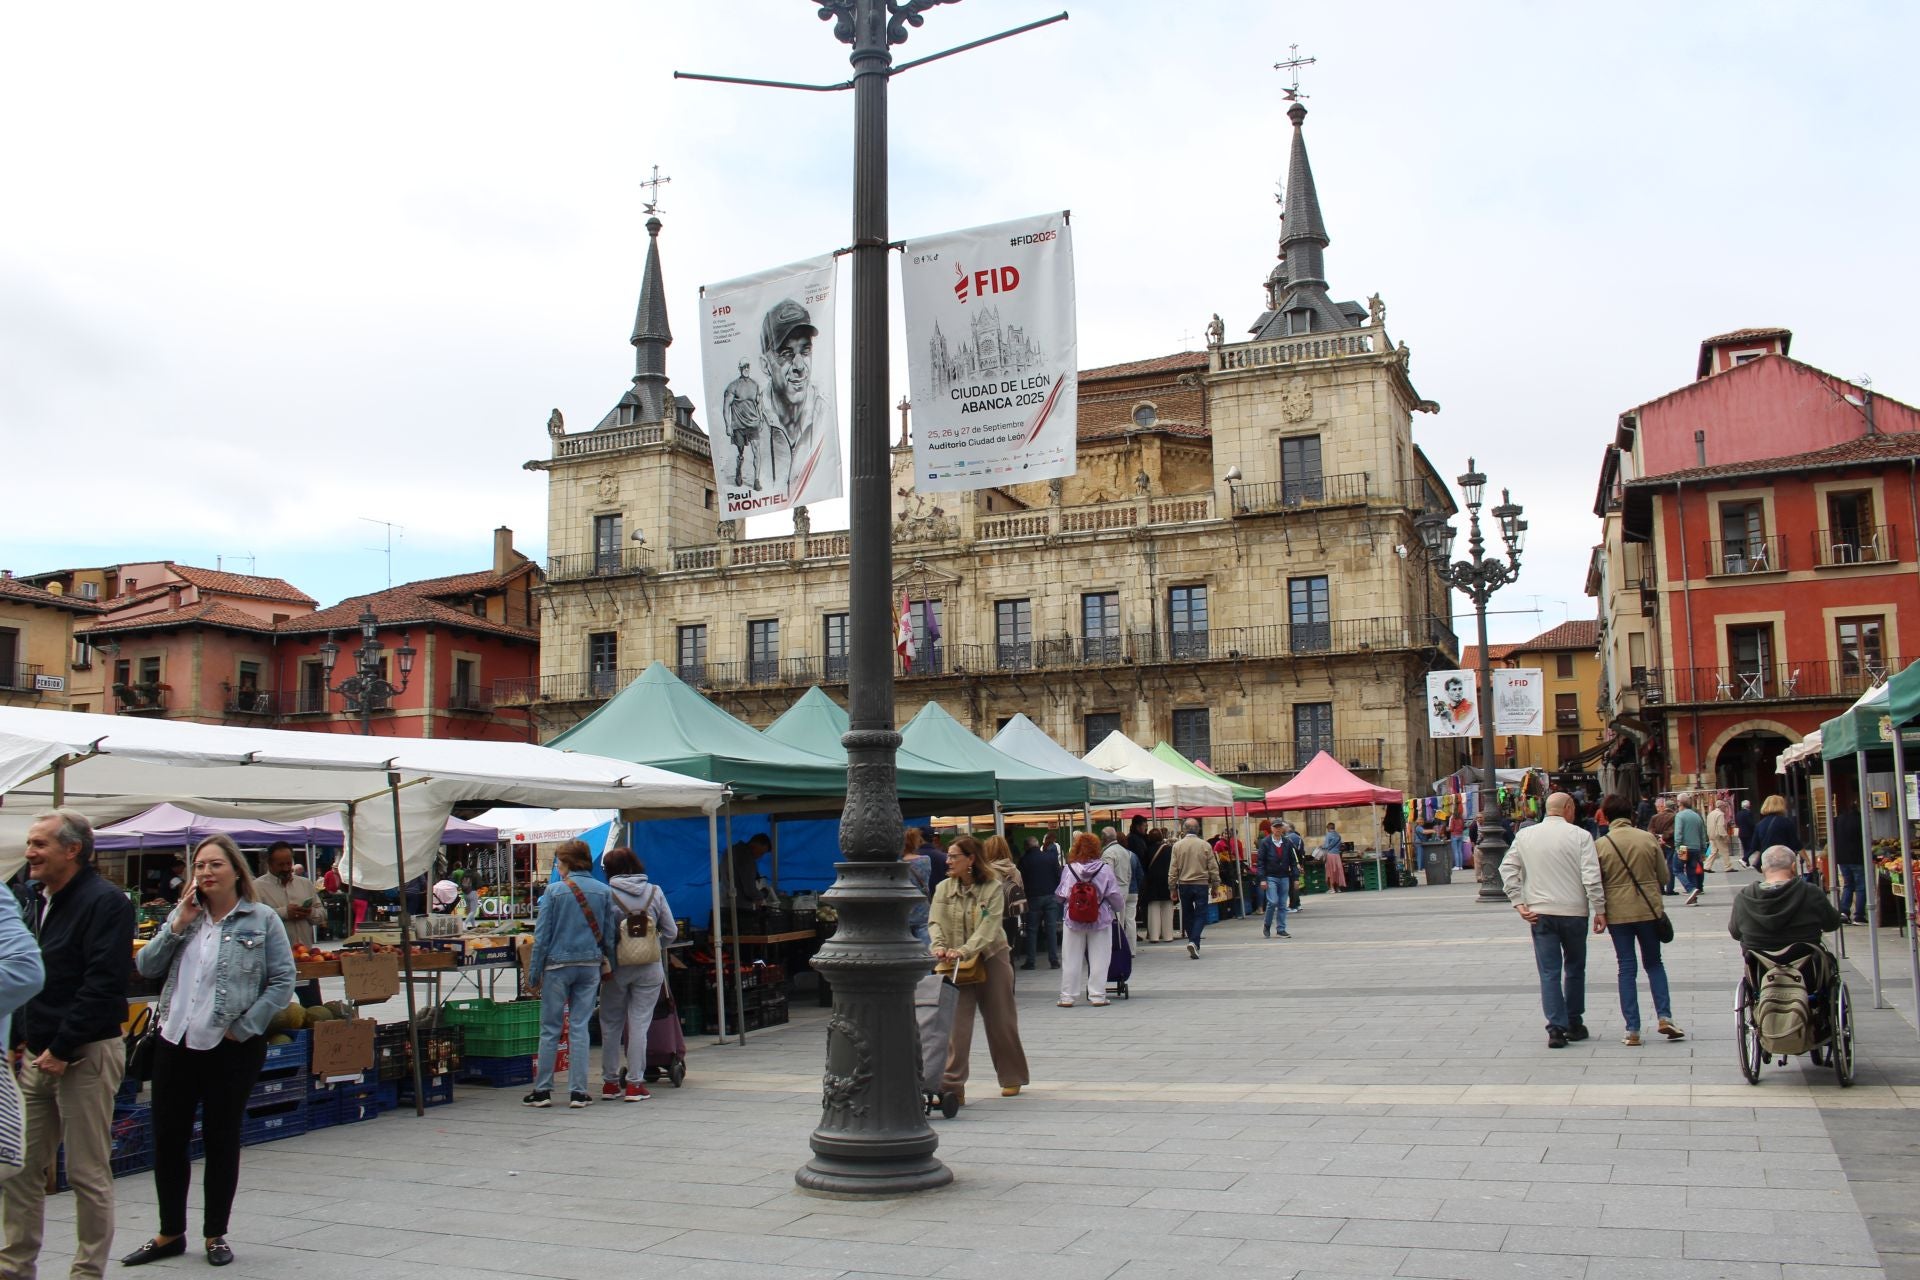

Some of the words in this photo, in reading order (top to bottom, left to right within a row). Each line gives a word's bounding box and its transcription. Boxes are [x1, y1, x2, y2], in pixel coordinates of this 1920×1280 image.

[1010, 230, 1057, 247] #FID2025
[974, 265, 1020, 297] FID
[805, 296, 814, 304] 27
[718, 305, 731, 316] FID
[951, 383, 998, 400] CIUDAD
[1001, 380, 1018, 393] DE
[1020, 373, 1050, 390] LEÓN
[961, 396, 1013, 414] ABANCA
[1015, 391, 1045, 407] 2025
[928, 430, 940, 439] 25,
[942, 429, 953, 437] 26
[954, 430, 960, 438] y
[961, 426, 970, 435] 27
[971, 426, 982, 434] de
[983, 420, 1025, 432] Septiembre
[928, 440, 967, 450] Auditorio
[968, 436, 995, 447] Ciudad
[996, 434, 1006, 443] de
[1007, 432, 1026, 442] León
[727, 490, 752, 501] Paul
[728, 493, 788, 512] MONTIEL
[1514, 679, 1528, 687] FID
